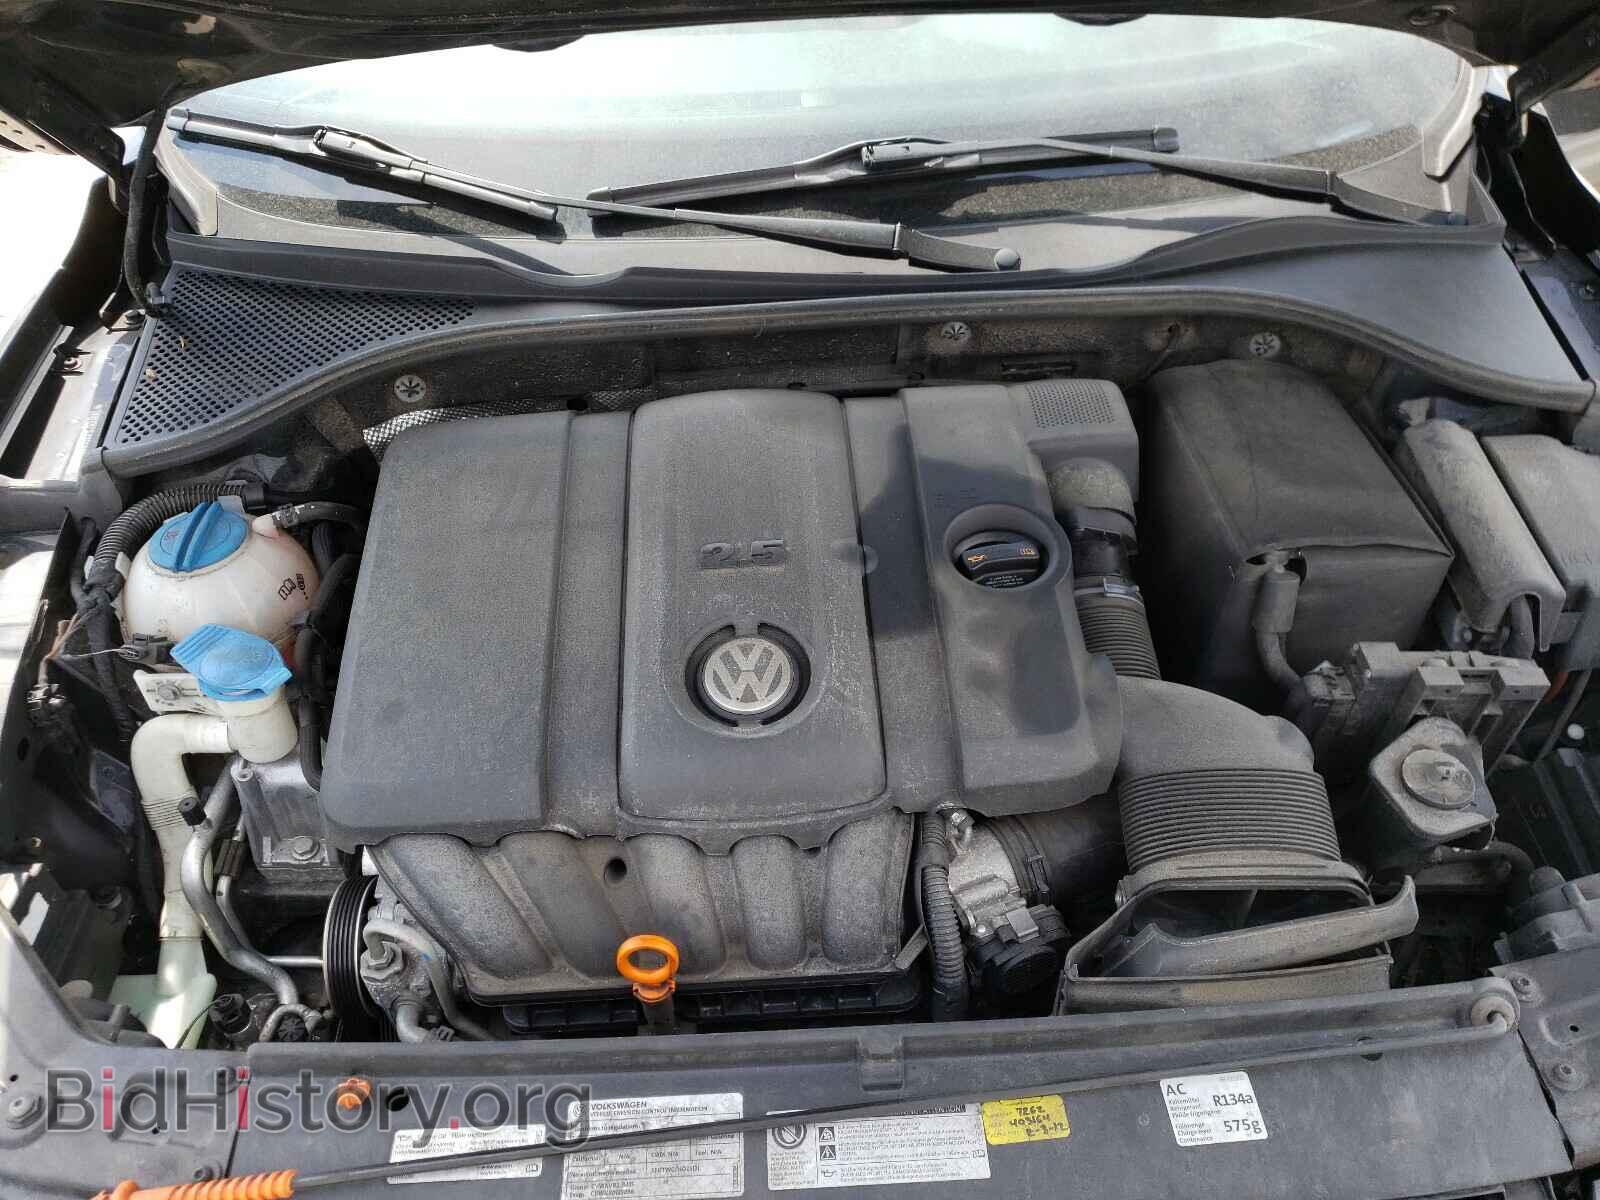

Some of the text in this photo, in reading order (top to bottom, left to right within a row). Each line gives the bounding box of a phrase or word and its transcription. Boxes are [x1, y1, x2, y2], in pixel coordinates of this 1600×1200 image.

[704, 638, 791, 712] VW
[1166, 1083, 1187, 1097] AC
[591, 1101, 647, 1110] VOLKSWAGEN
[1213, 1093, 1254, 1107] R134a
[1223, 1118, 1262, 1134] 575g
